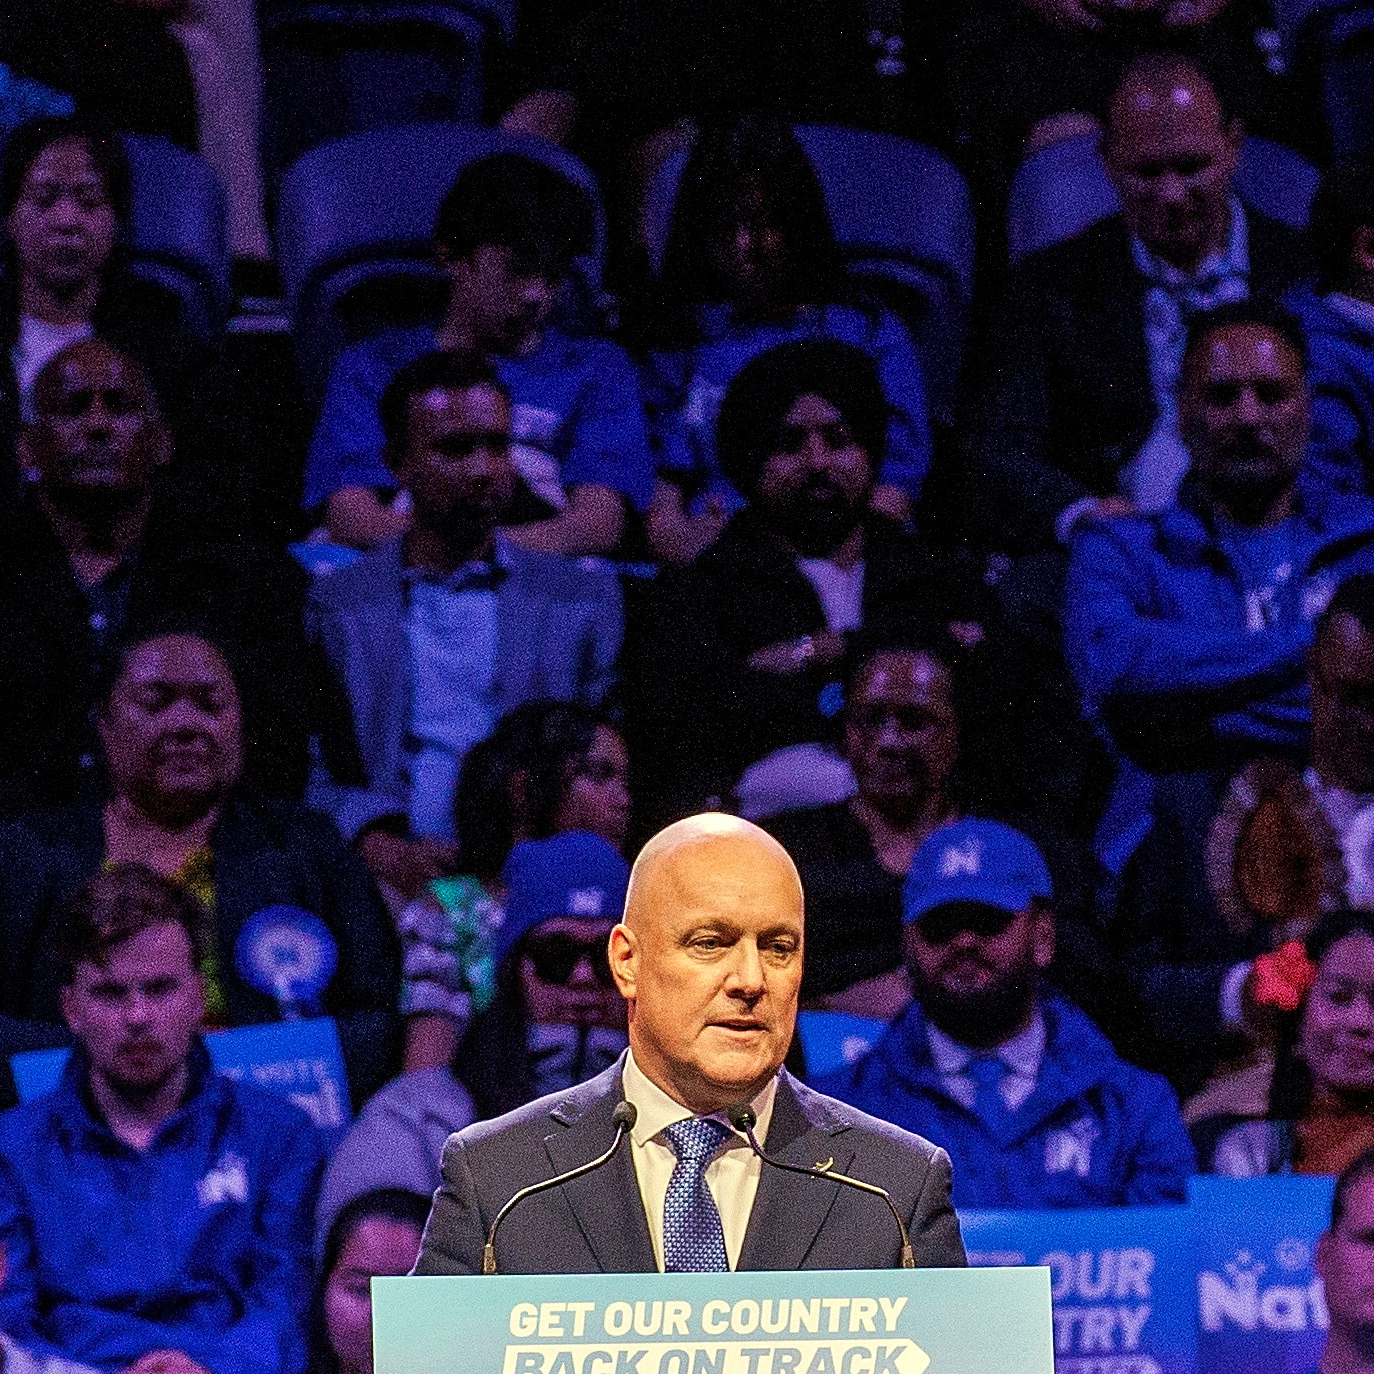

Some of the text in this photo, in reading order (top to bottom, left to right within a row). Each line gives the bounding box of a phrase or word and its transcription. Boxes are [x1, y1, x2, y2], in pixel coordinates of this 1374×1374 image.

[509, 1297, 909, 1338] GET OUR COUNTRY
